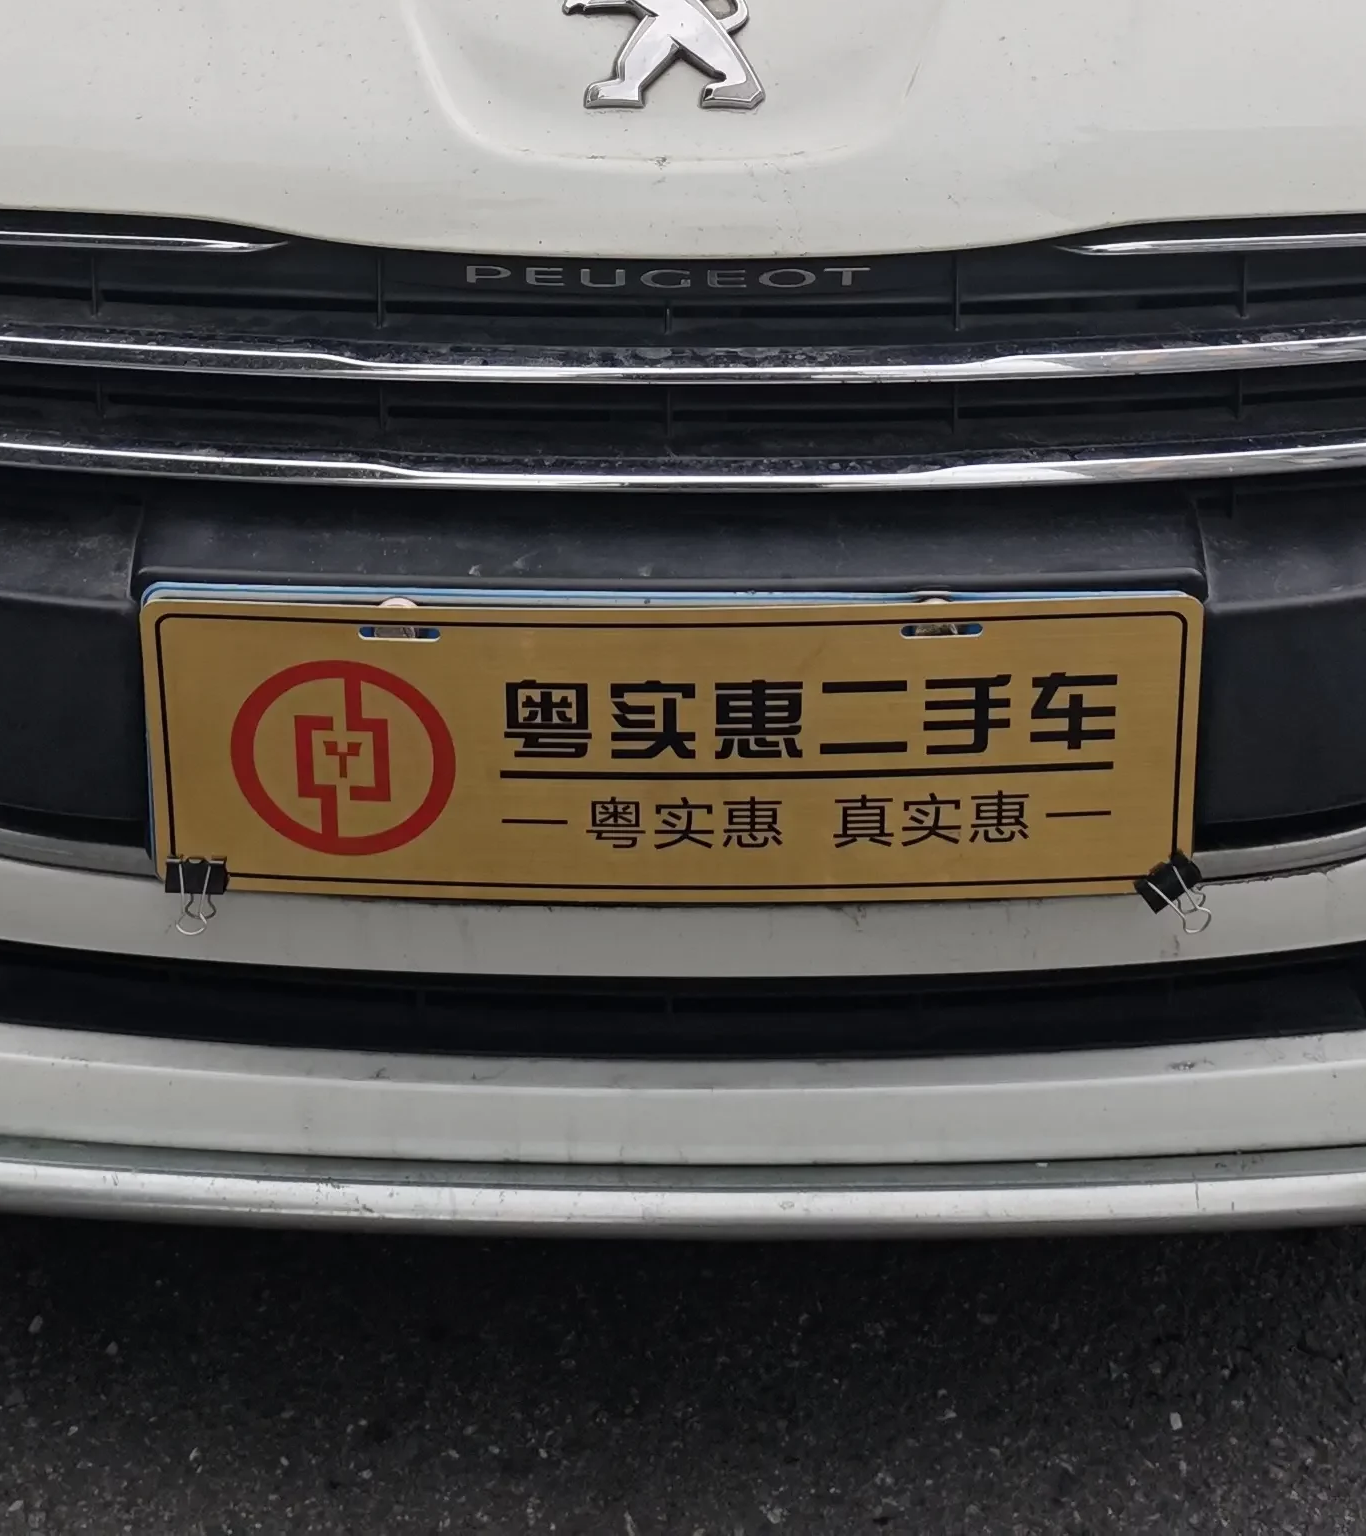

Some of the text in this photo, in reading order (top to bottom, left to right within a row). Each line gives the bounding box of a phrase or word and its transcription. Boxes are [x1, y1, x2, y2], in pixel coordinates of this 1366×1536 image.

[465, 264, 871, 289] PEUGEOT
[502, 670, 1118, 761] 粤实惠二手车
[584, 789, 1031, 850] 粤实惠 真实惠
